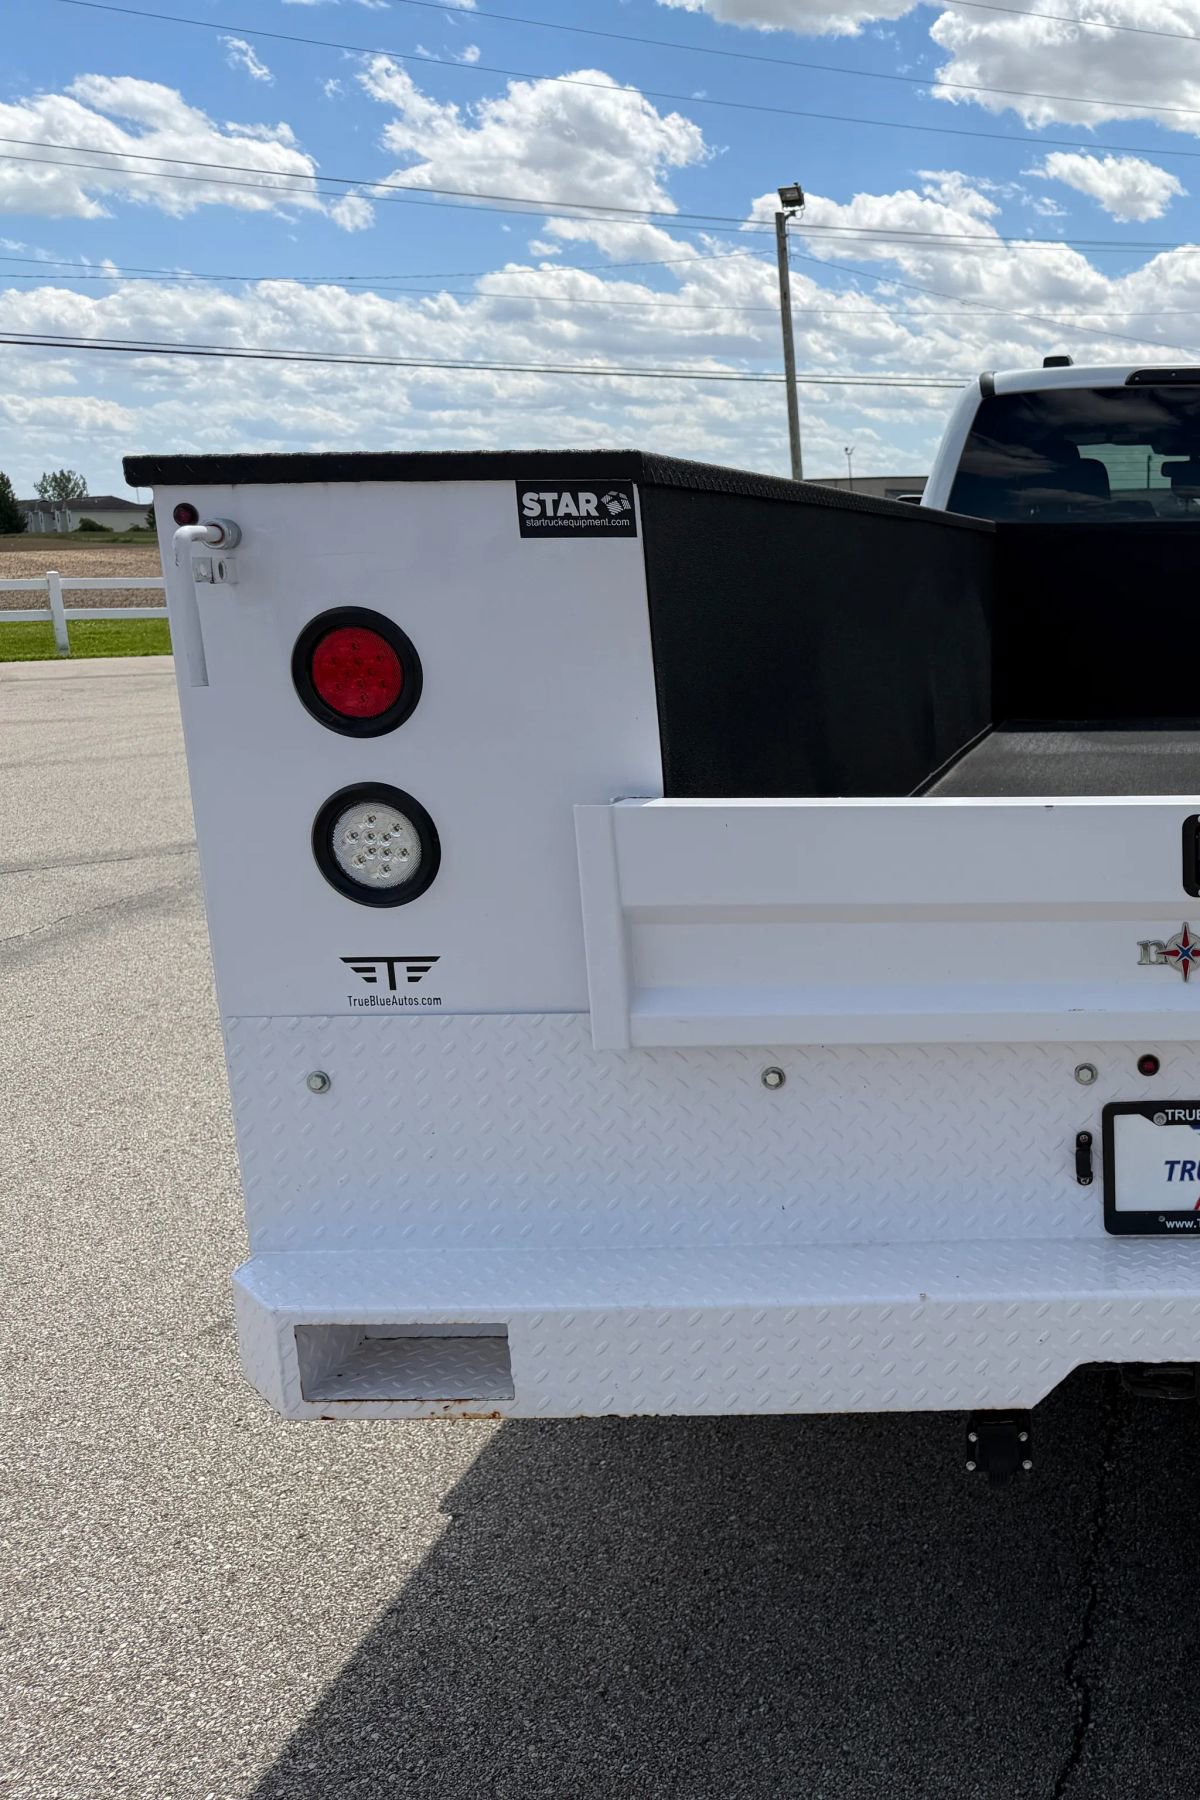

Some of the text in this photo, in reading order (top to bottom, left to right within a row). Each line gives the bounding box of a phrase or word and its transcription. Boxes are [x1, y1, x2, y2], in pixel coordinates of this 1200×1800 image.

[522, 492, 599, 517] STAR
[526, 518, 630, 528] startruckequipment.com
[347, 995, 442, 1007] TrueBlueAutos.com
